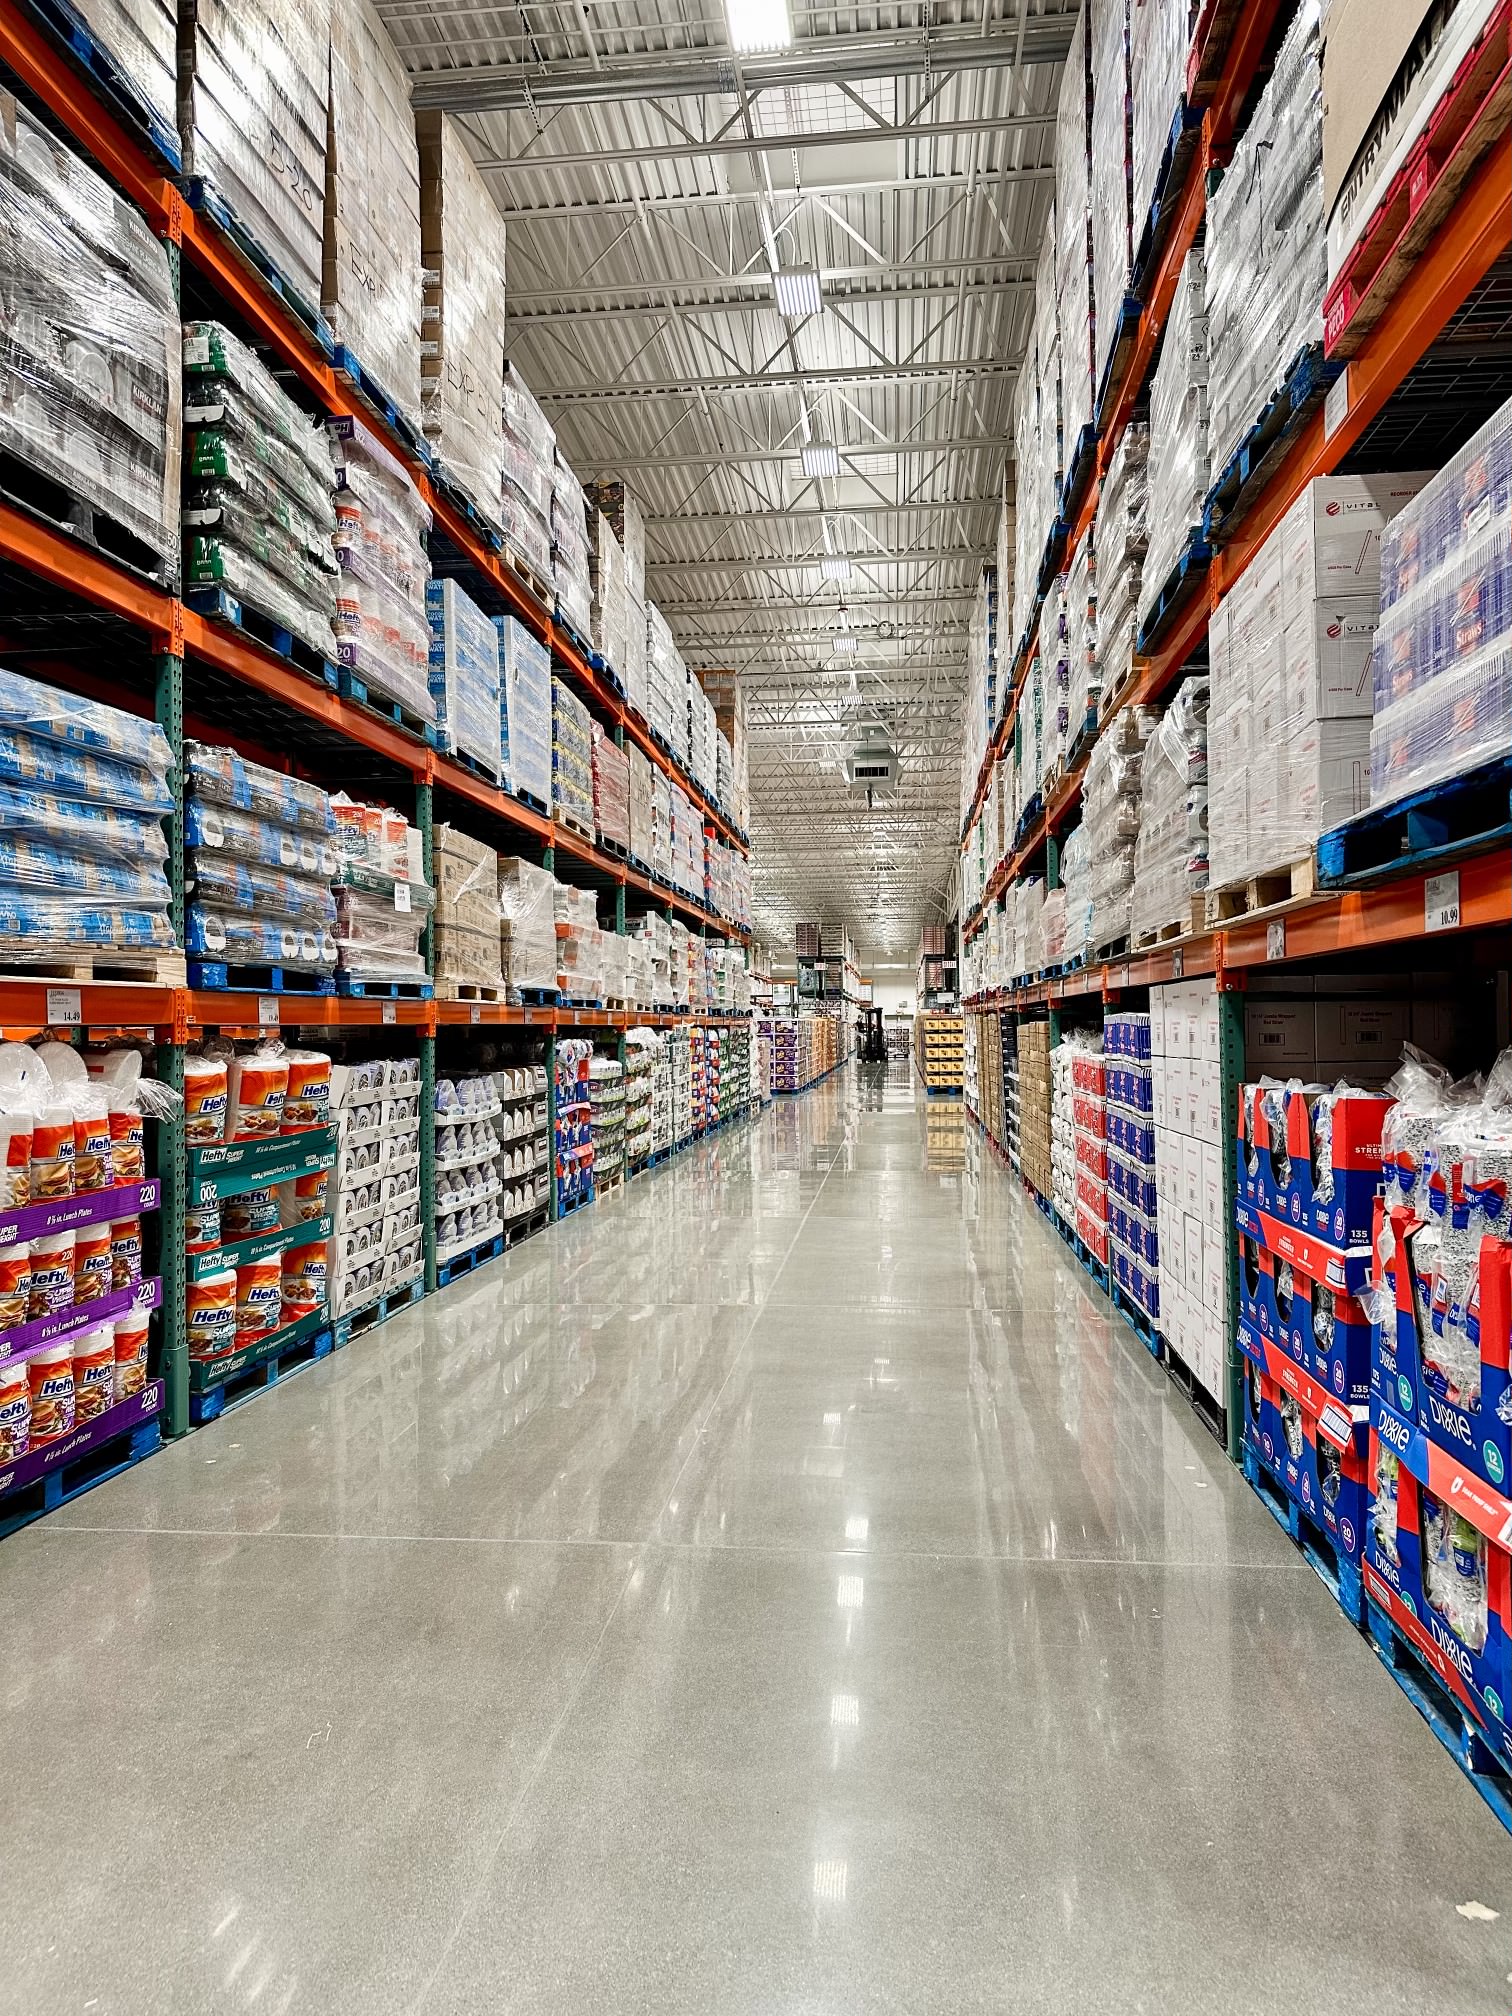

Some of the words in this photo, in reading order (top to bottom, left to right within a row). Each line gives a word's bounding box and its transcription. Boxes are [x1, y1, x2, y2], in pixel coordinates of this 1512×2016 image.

[129, 219, 158, 253] KIRKLAND
[1328, 308, 1345, 344] PECO
[1456, 622, 1483, 648] Straws
[1441, 909, 1458, 925] 10.99
[64, 1011, 80, 1021] 14.49
[202, 1149, 226, 1162] Hefty
[226, 1150, 244, 1160] SUPER
[140, 1185, 156, 1204] 220
[200, 1185, 217, 1201] 200
[63, 1211, 77, 1221] Lunch
[78, 1208, 92, 1218] Plates
[0, 1225, 18, 1236] UPER
[320, 1217, 330, 1232] 200
[0, 1232, 17, 1244] EIGHT
[1351, 1230, 1367, 1238] 135
[110, 1238, 138, 1253] Hefty
[62, 1249, 73, 1261] 220
[200, 1254, 220, 1269] Hefty
[30, 1270, 67, 1285] Hefty
[138, 1282, 155, 1301] 220
[58, 1320, 74, 1331] Lunch
[74, 1315, 89, 1325] Plates
[195, 1308, 233, 1323] Hefty
[1352, 1385, 1368, 1393] 135
[1400, 1383, 1408, 1396] 12
[141, 1386, 158, 1409] 220
[0, 1402, 26, 1419] efty
[61, 1440, 77, 1454] Lunch
[1488, 1449, 1498, 1465] 12
[1343, 1525, 1351, 1538] 20
